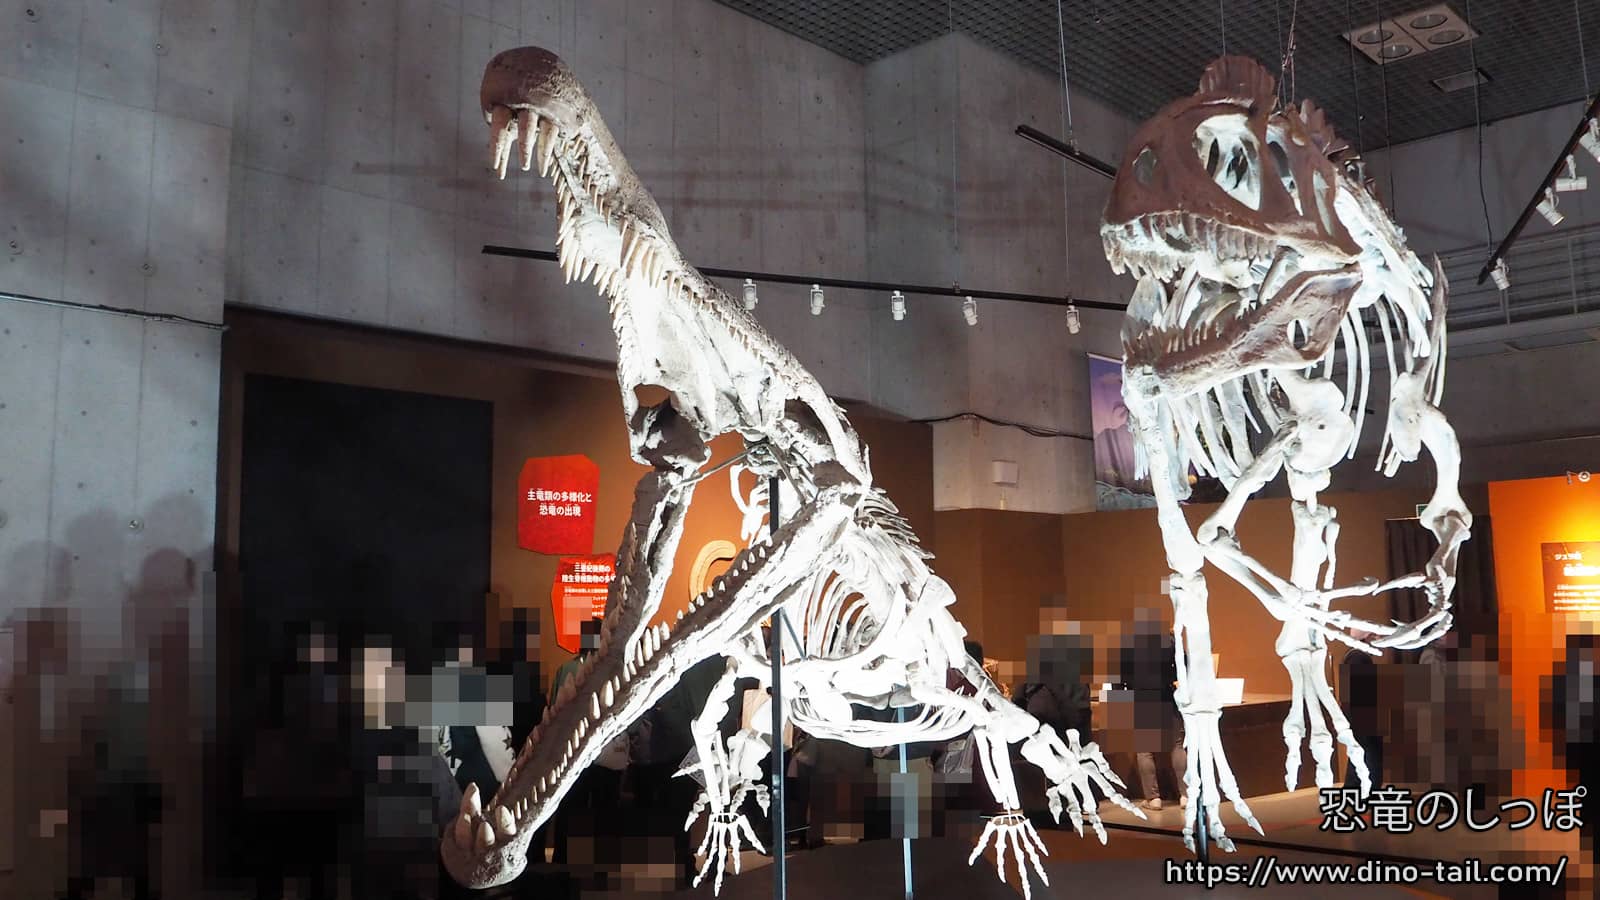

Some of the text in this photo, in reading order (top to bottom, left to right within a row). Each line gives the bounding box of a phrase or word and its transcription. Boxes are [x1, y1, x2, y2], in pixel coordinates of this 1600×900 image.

[527, 490, 592, 503] 主竜類の多様化と
[539, 504, 581, 517] 恐竜の出現
